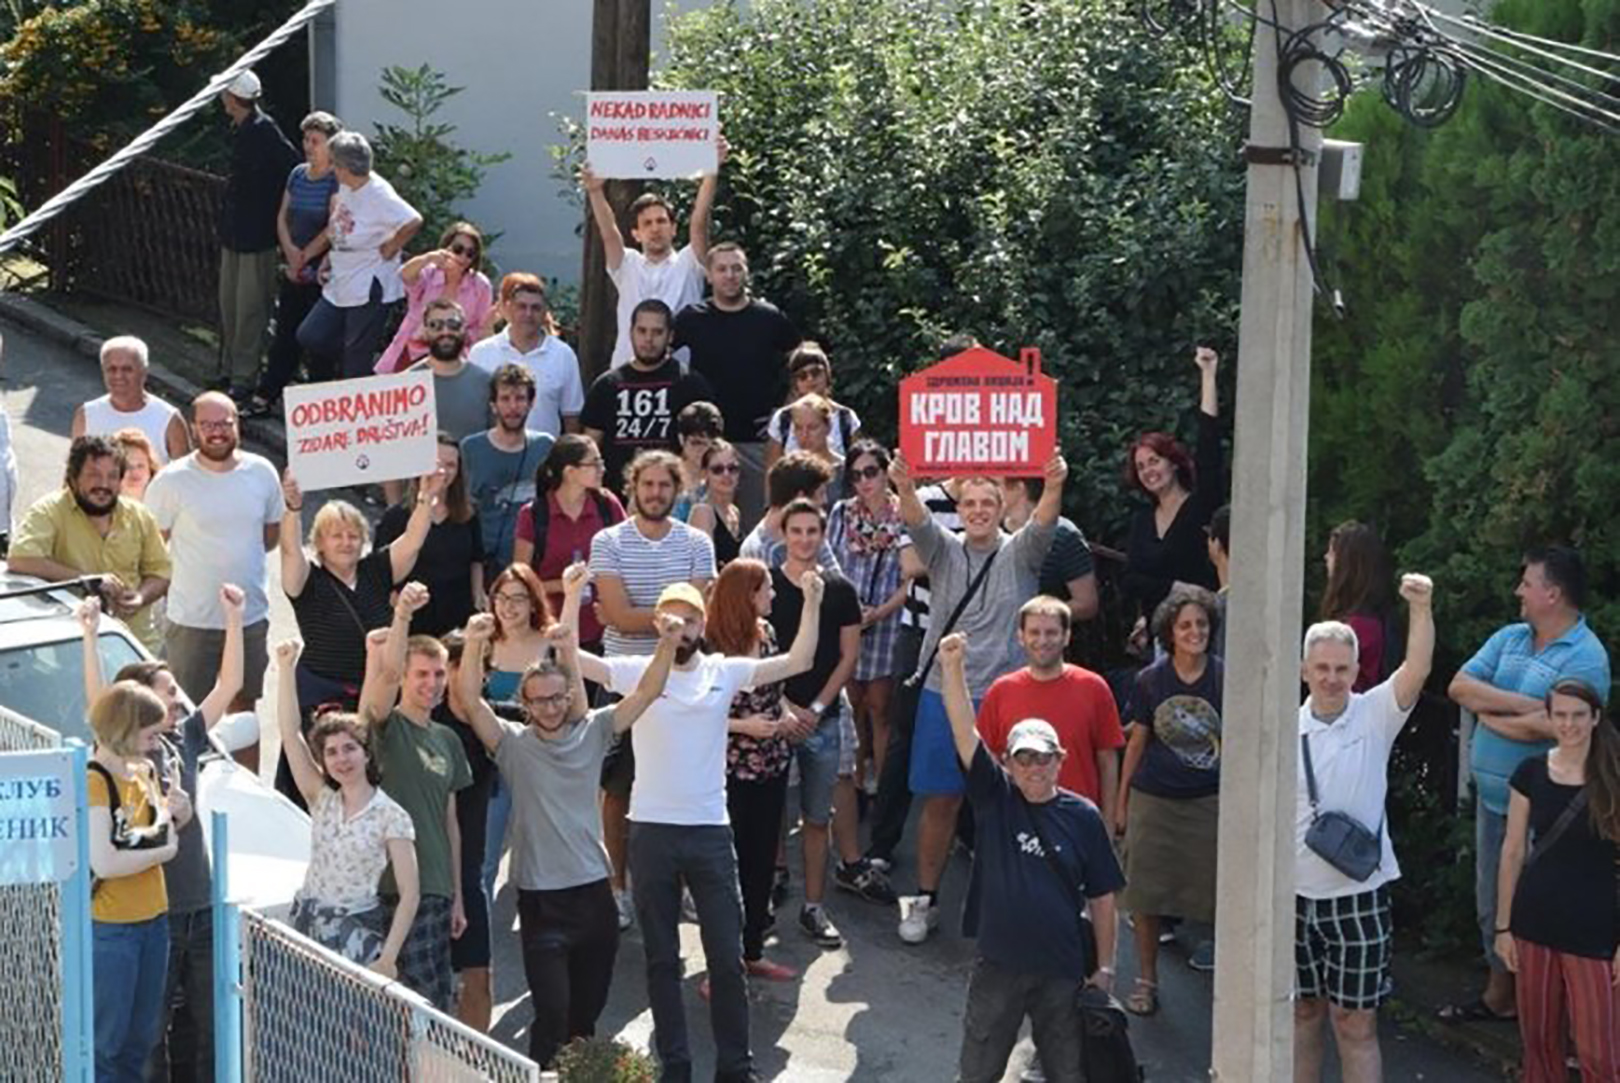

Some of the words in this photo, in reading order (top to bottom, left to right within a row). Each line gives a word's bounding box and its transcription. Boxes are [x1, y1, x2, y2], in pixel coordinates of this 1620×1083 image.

[591, 101, 646, 119] NEKAD
[648, 101, 711, 119] RADNICI
[291, 384, 427, 428] ODBRANIMO
[616, 387, 671, 417] 161
[911, 391, 981, 425] КРОВ
[990, 391, 1044, 428] НАД
[298, 430, 352, 454] ZIDARE
[357, 413, 428, 444] DRUŠTVA!
[616, 417, 672, 438] 24/7
[924, 430, 1029, 462] ГЛАВОМ
